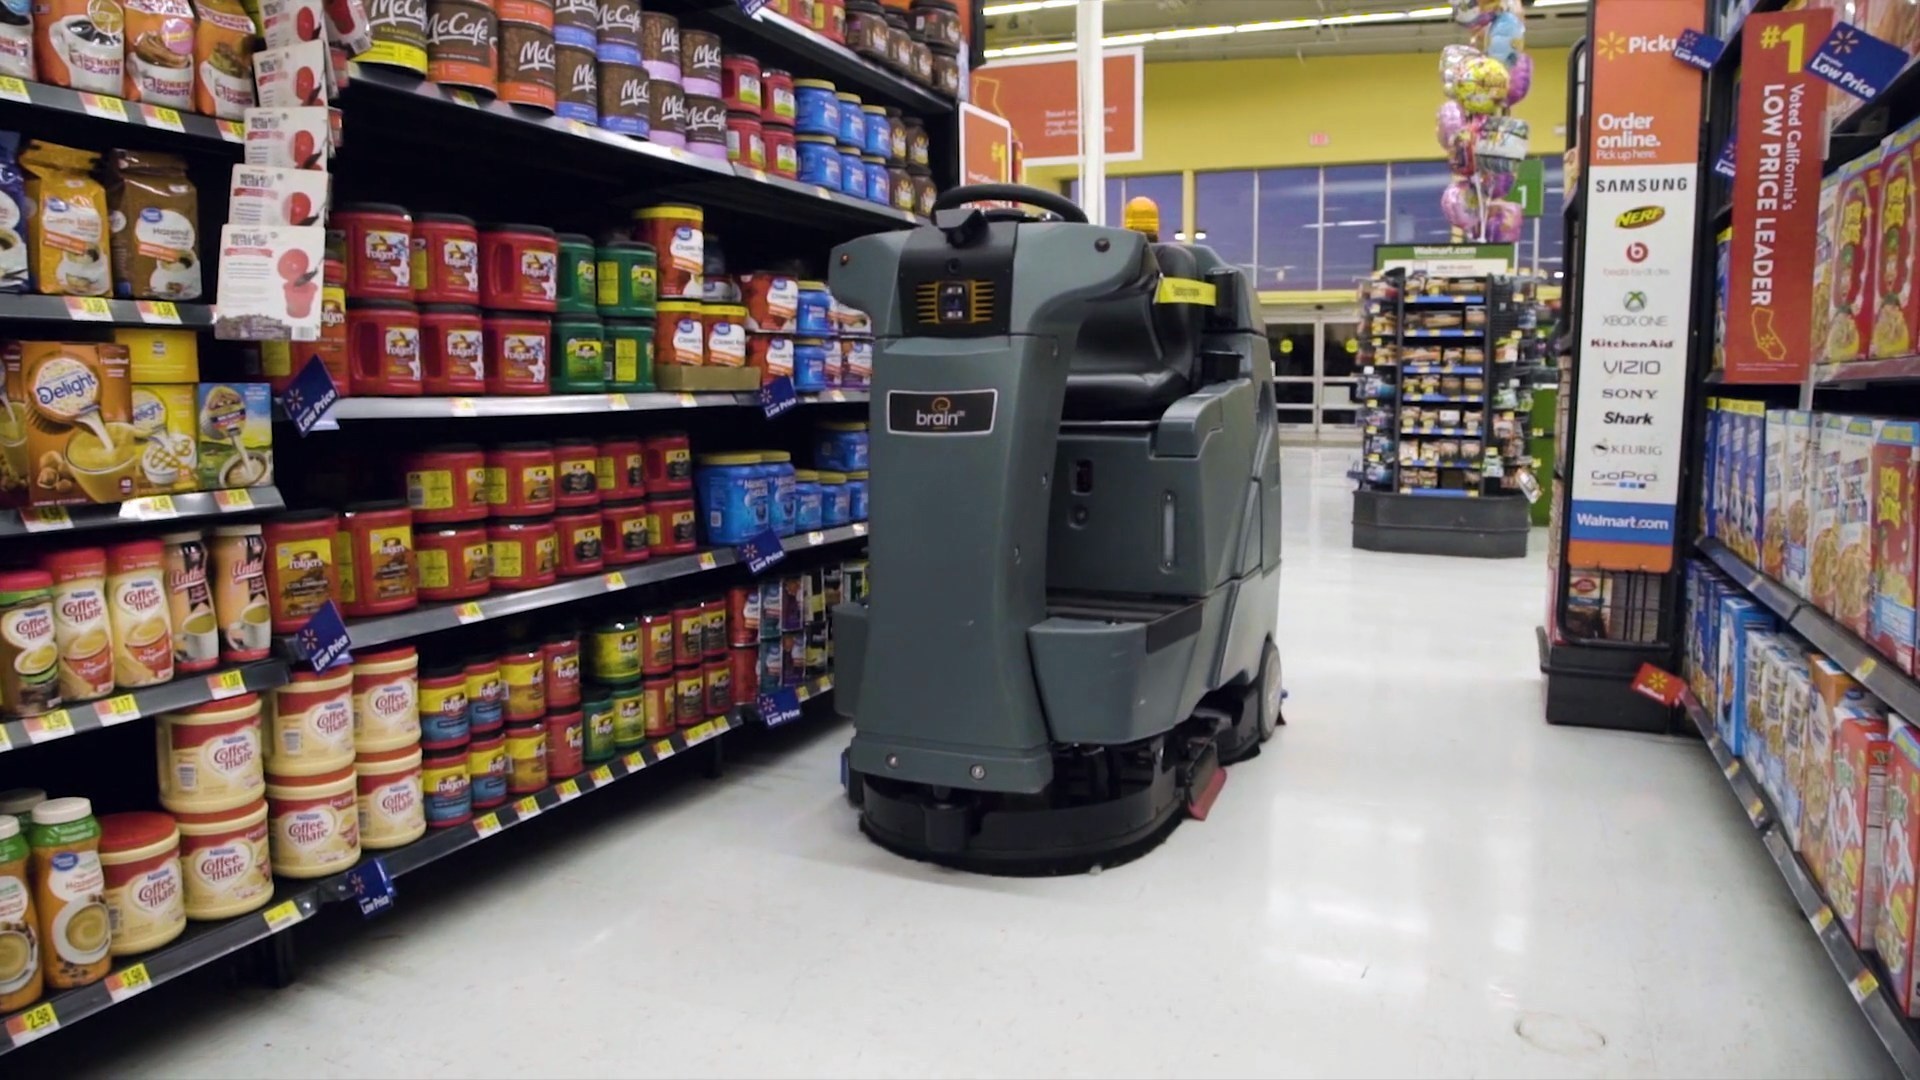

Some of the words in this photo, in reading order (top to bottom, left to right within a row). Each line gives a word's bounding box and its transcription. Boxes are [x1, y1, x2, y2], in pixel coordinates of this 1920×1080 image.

[1760, 22, 1805, 74] #1
[1811, 57, 1842, 80] Low
[1840, 71, 1876, 98] Price
[1762, 84, 1786, 136] LOW
[1788, 83, 1806, 127] Voted
[1597, 112, 1655, 131] Order
[1596, 130, 1661, 149] online.
[1596, 149, 1616, 160] Pick
[1619, 151, 1632, 162] up
[1756, 142, 1783, 212] PRICE
[1782, 127, 1803, 211] California's
[1596, 177, 1688, 193] SAMSUNG
[1615, 206, 1666, 229] NERF
[1751, 217, 1777, 306] LEADER
[1603, 315, 1638, 327] XBOX
[1638, 315, 1668, 327] ONE
[1591, 339, 1674, 349] KitchenAid
[1603, 360, 1661, 375] VIZIO
[37, 374, 97, 405] Delight
[1602, 389, 1659, 400] SONY
[134, 402, 164, 423] elight
[915, 409, 959, 426] brain
[1603, 411, 1655, 426] Shark
[1610, 444, 1664, 457] KEURIG
[1590, 470, 1660, 483] GoPro
[1576, 512, 1669, 531] Walmart.com
[123, 587, 156, 605] Coffee
[62, 598, 99, 616] Coffee
[16, 615, 49, 634] Coffee
[312, 653, 331, 671] Low
[327, 635, 349, 659] Price
[375, 692, 407, 711] Coffee
[316, 709, 349, 729] Coffee
[214, 743, 251, 764] Coffee
[382, 791, 414, 811] Coffee
[288, 818, 325, 839] Coffee
[201, 853, 240, 875] Coffee
[138, 877, 174, 904] Coffee
[26, 1009, 52, 1027] 2.98
